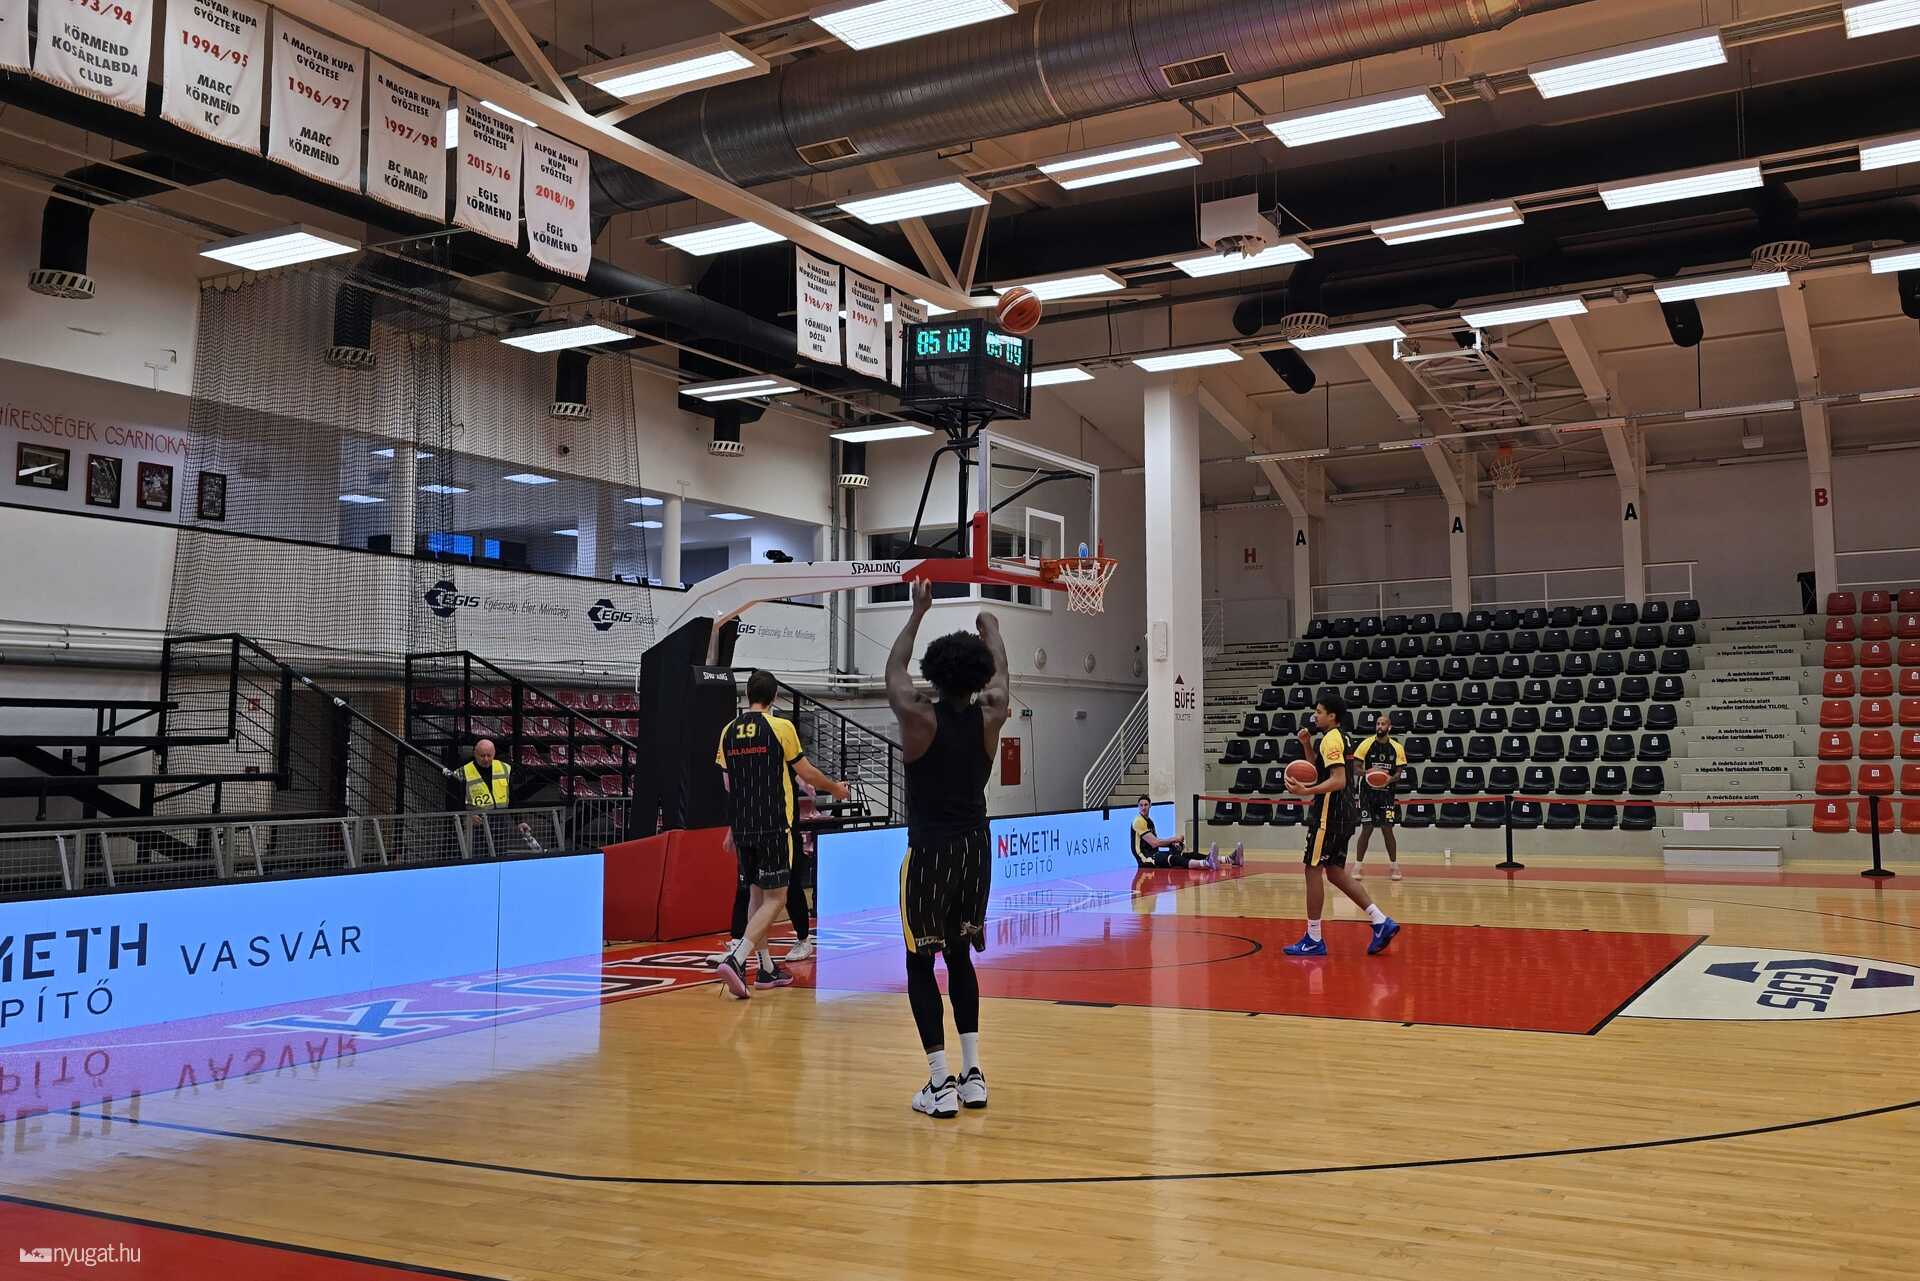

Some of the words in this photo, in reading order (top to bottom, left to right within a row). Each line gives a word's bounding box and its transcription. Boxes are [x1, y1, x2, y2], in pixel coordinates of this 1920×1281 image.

[194, 6, 241, 35] GYŐZTESE
[232, 10, 258, 28] KUPA
[64, 22, 129, 56] KÖRMEND
[181, 30, 250, 68] 1994/95
[51, 35, 139, 78] KOSÁRLABDA
[282, 32, 289, 43] A
[291, 37, 329, 63] MAGYAR
[331, 57, 355, 73] KUPA
[79, 67, 114, 88] CLUB
[296, 53, 340, 81] GYŐZTESE
[197, 74, 233, 96] MARC
[288, 76, 350, 112] 1996/97
[378, 75, 384, 85] A
[386, 78, 419, 102] MAGYAR
[420, 93, 441, 110] KUPA
[185, 84, 241, 116] KÖRMEND
[391, 94, 430, 117] GYŐZTESE
[204, 111, 221, 127] KC
[465, 115, 495, 136] MAGYAR
[496, 128, 515, 145] KUPA
[493, 117, 514, 134] TIBOR
[300, 126, 332, 147] MARC
[384, 116, 438, 148] 1997/98
[288, 136, 340, 166] KÖRMEND
[534, 141, 557, 159] ALPOK
[558, 151, 579, 167] ADRIA
[388, 160, 401, 173] BC
[466, 153, 512, 182] 2015/16
[548, 157, 567, 172] KUPA
[384, 174, 429, 200] KÖRMEND
[478, 186, 499, 204] EGIS
[535, 184, 576, 210] 2018/19
[466, 194, 512, 222] KÖRMEND
[546, 222, 564, 237] EGIS
[532, 230, 578, 253] KÖRMEND
[104, 425, 188, 455] CSARNOKA
[1814, 488, 1828, 507] B
[1624, 502, 1638, 520] A
[1451, 516, 1464, 534] A
[1295, 529, 1307, 546] A
[1244, 548, 1257, 563] H
[851, 560, 901, 575] SPALDING
[442, 593, 481, 608] EGIS
[602, 609, 633, 623] EGIS
[738, 623, 757, 634] GIS
[1174, 688, 1195, 709] BÜFÉ
[736, 722, 757, 739] 19
[475, 793, 491, 806] 62
[998, 828, 1060, 859] NÉMETH
[1066, 832, 1110, 857] VASVÁR
[1005, 856, 1053, 879] ÚTÉPÍTŐ
[180, 920, 362, 975] VASVÁR
[1757, 971, 1839, 1012] EGIS
